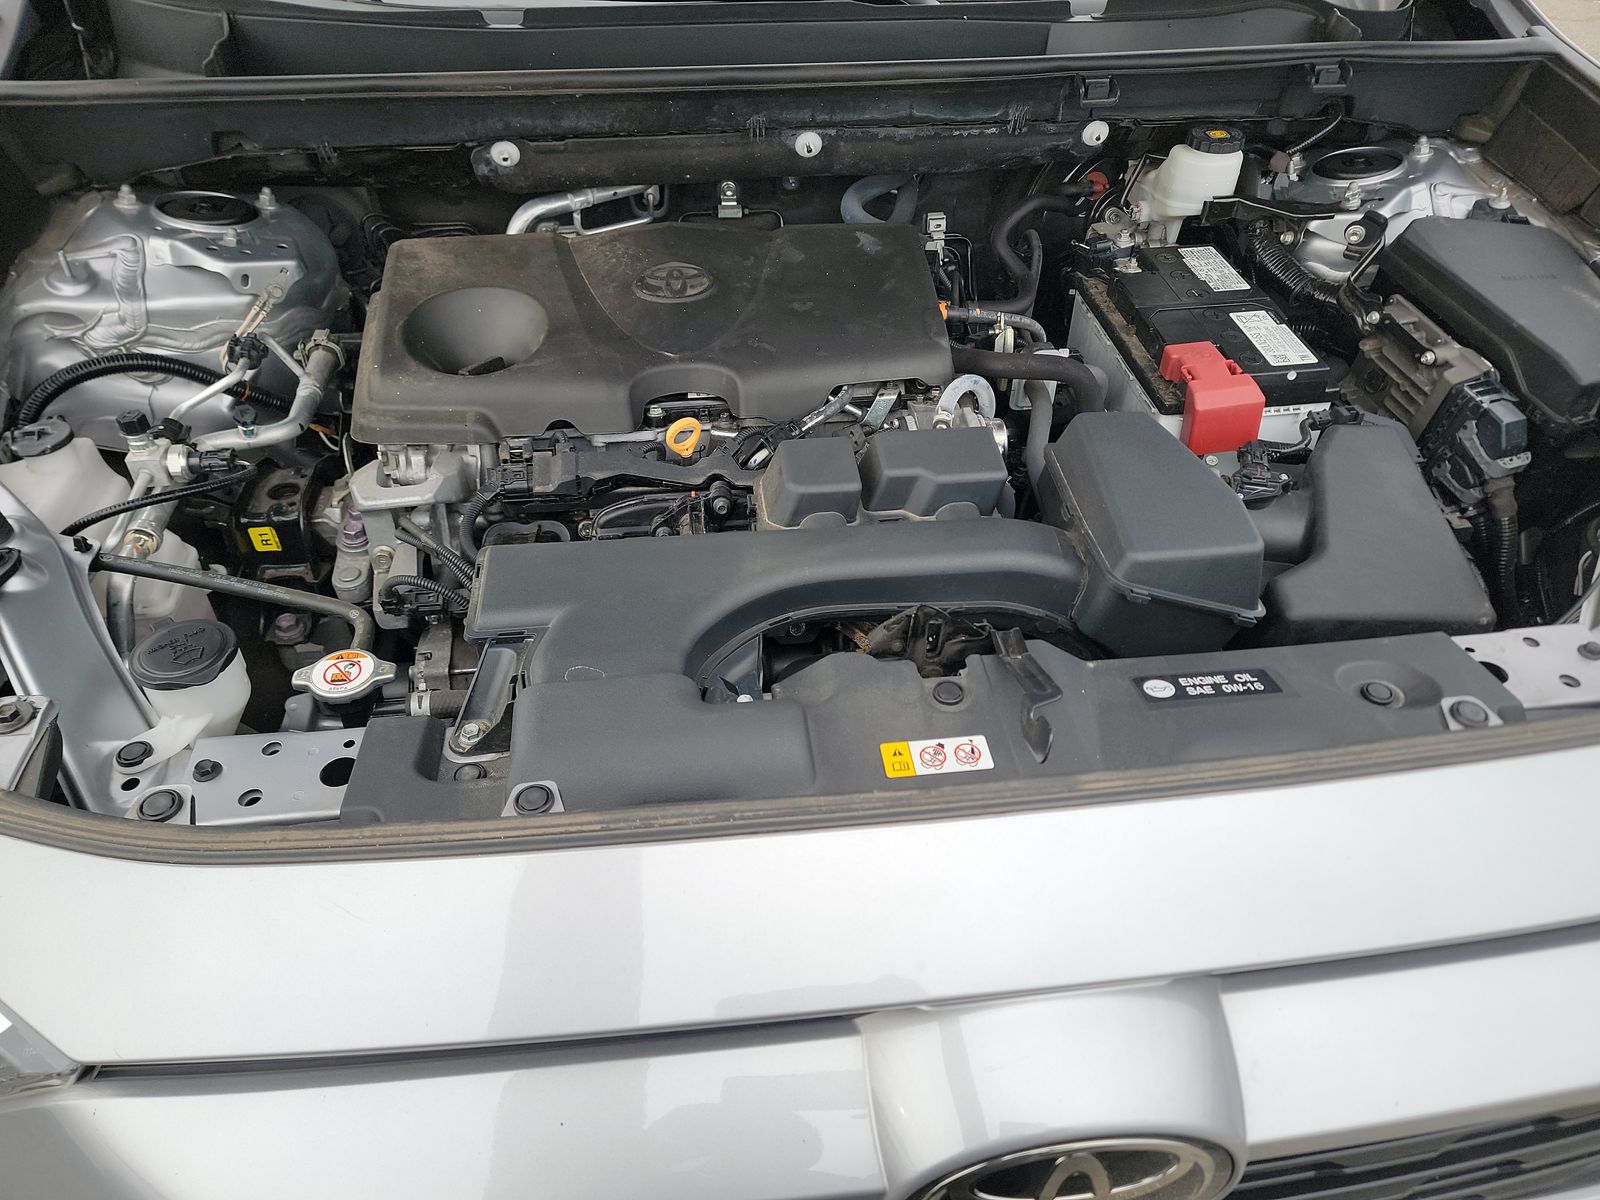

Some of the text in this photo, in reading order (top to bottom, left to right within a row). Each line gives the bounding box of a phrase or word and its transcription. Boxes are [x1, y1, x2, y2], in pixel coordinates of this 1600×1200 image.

[258, 533, 273, 546] R1
[1178, 673, 1258, 686] ENGINE OIL
[1186, 682, 1265, 695] SAE 0W-16
